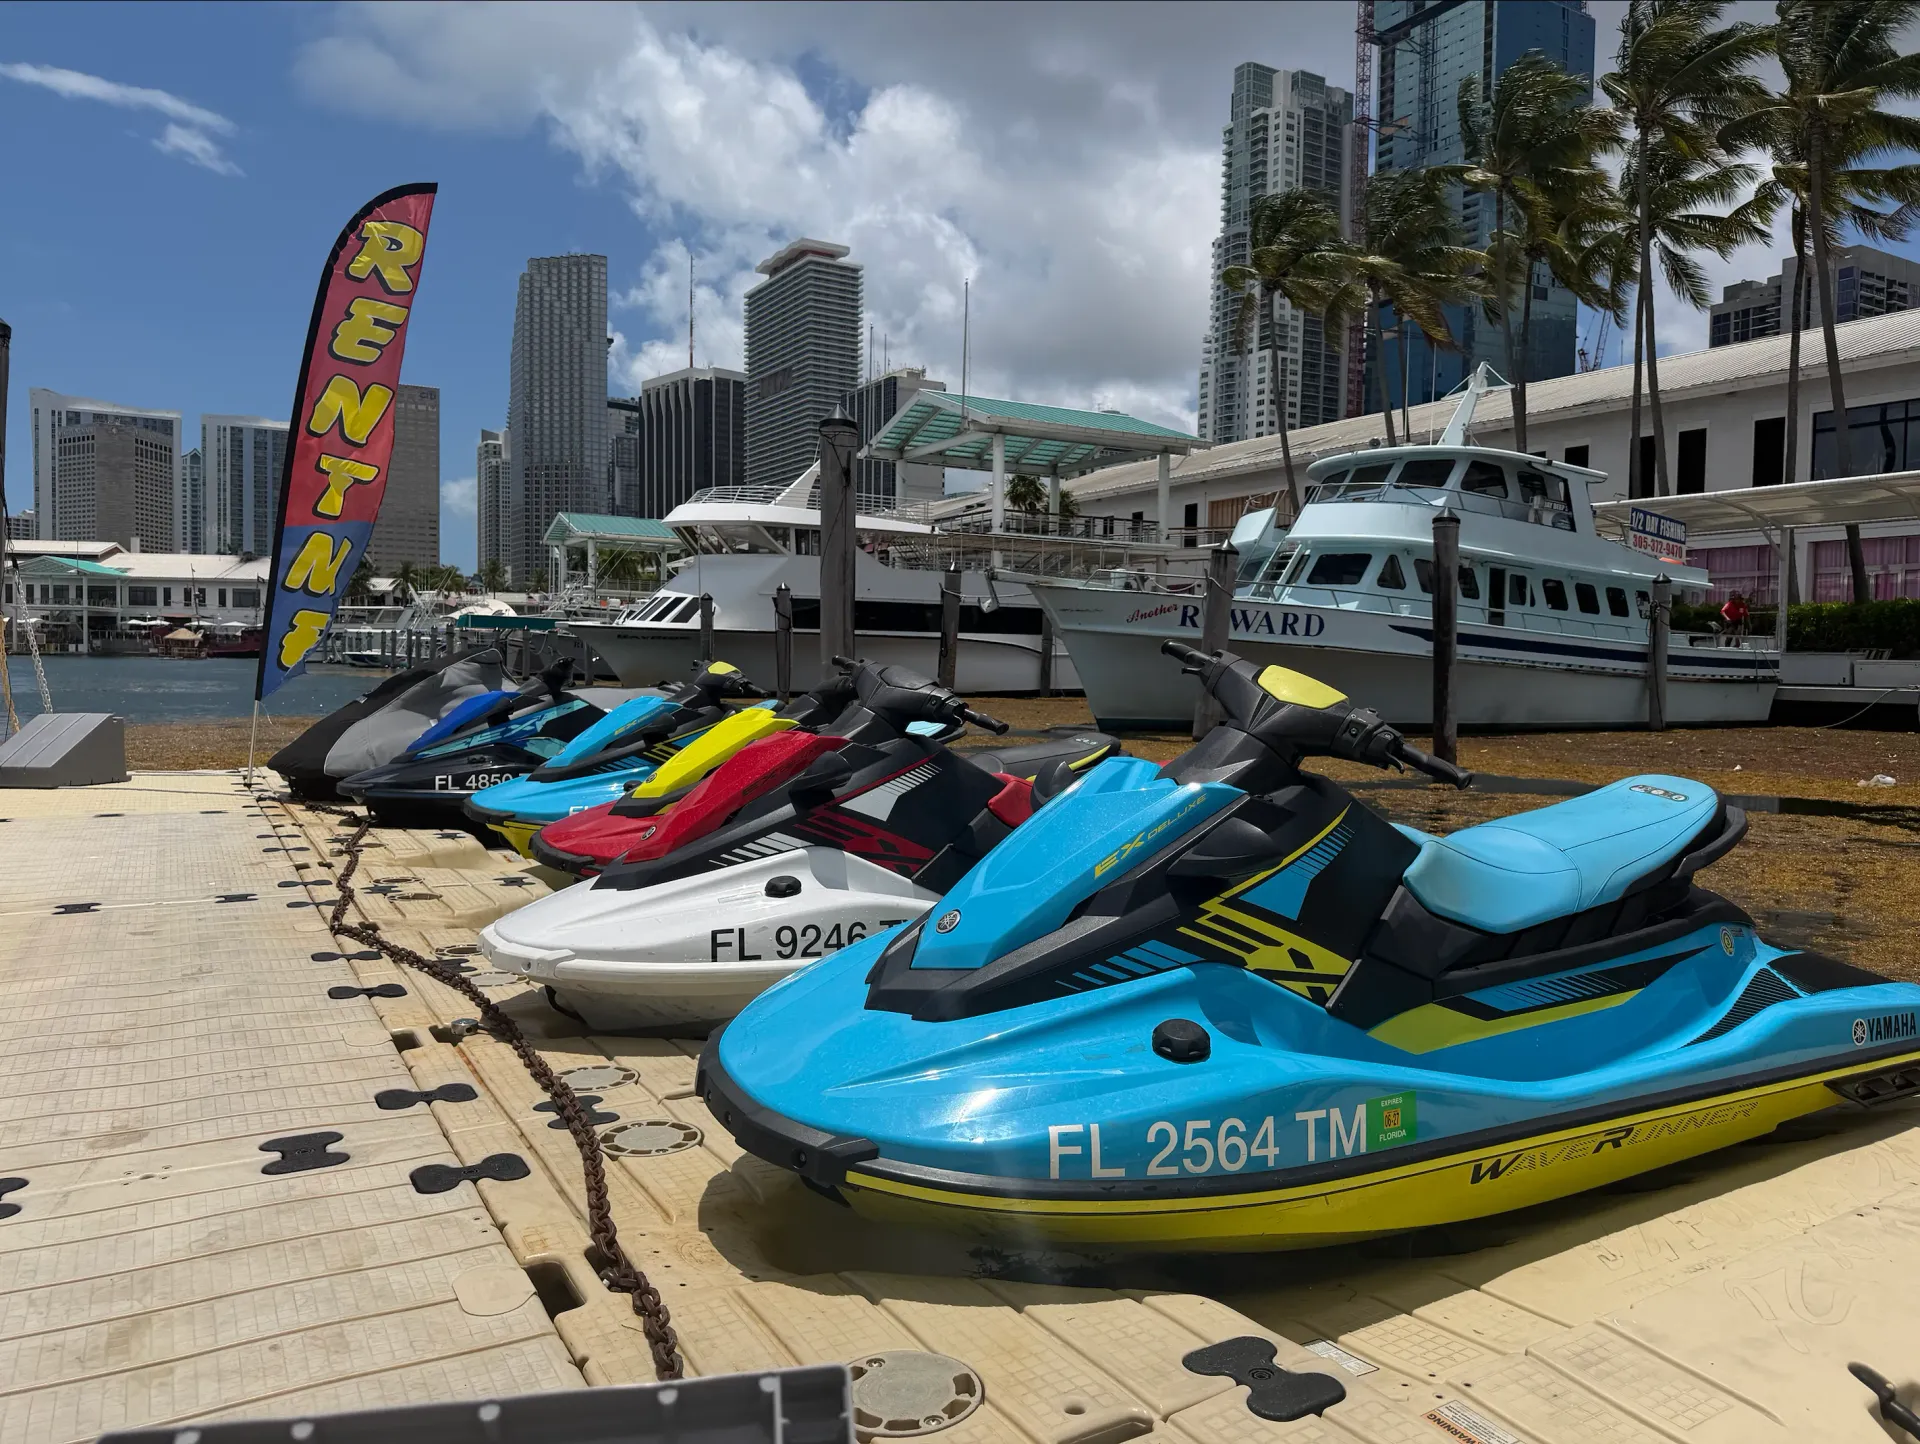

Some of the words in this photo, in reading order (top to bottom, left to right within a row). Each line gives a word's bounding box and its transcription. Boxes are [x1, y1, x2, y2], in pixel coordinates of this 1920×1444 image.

[1631, 511, 1644, 531] 1/2
[1645, 514, 1659, 535] DAY
[1659, 518, 1686, 542] FISHING
[1632, 533, 1683, 559] 305-372-9470
[1126, 603, 1178, 624] Another
[1179, 604, 1325, 637] RWARD
[434, 775, 460, 791] FL
[465, 773, 513, 790] 4850
[1094, 832, 1145, 880] EX
[1147, 793, 1207, 840] DELUXE
[711, 927, 762, 962] FL
[775, 921, 867, 959] 9246
[1867, 1012, 1917, 1042] YAMAHA
[1381, 1097, 1402, 1107] EXPIRES
[1048, 1122, 1126, 1180] FL
[1146, 1115, 1280, 1176] 2564
[1295, 1103, 1367, 1163] TM
[1379, 1129, 1406, 1141] FLORIDA
[1470, 1101, 1759, 1185] WAVERUNNER
[1426, 1413, 1477, 1444] WARNING
